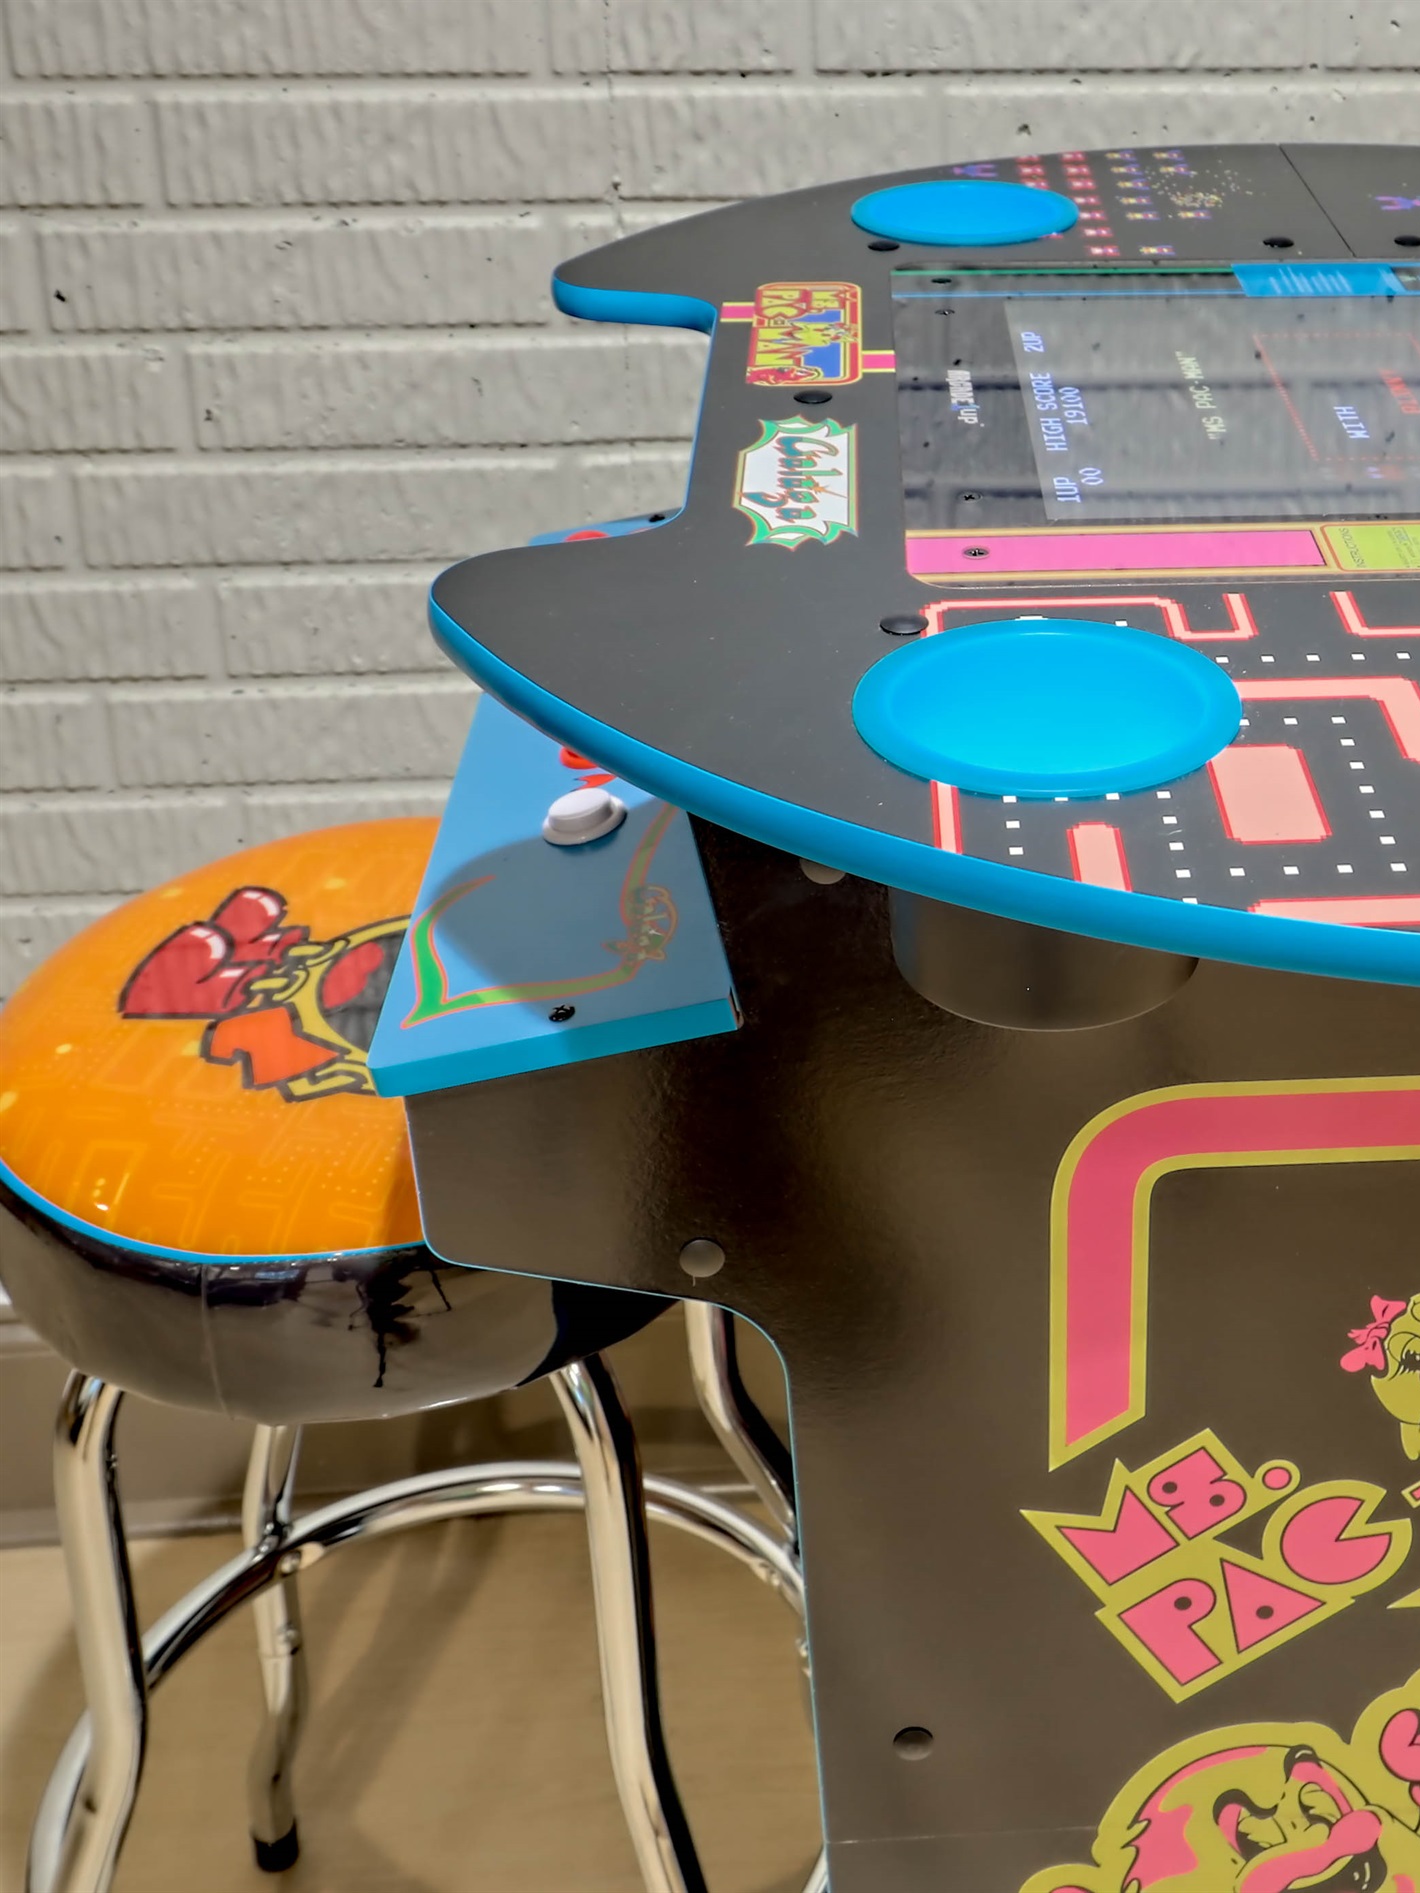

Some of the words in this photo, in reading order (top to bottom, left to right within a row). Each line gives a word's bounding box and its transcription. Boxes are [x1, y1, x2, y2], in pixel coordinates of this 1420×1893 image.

[1020, 330, 1046, 353] 2UP
[1029, 371, 1059, 412] SCORE
[1059, 386, 1088, 426] 19100
[1046, 417, 1069, 452] HIGH
[1333, 405, 1370, 440] WITH
[1053, 475, 1081, 504] 1UP
[1079, 466, 1105, 486] 00
